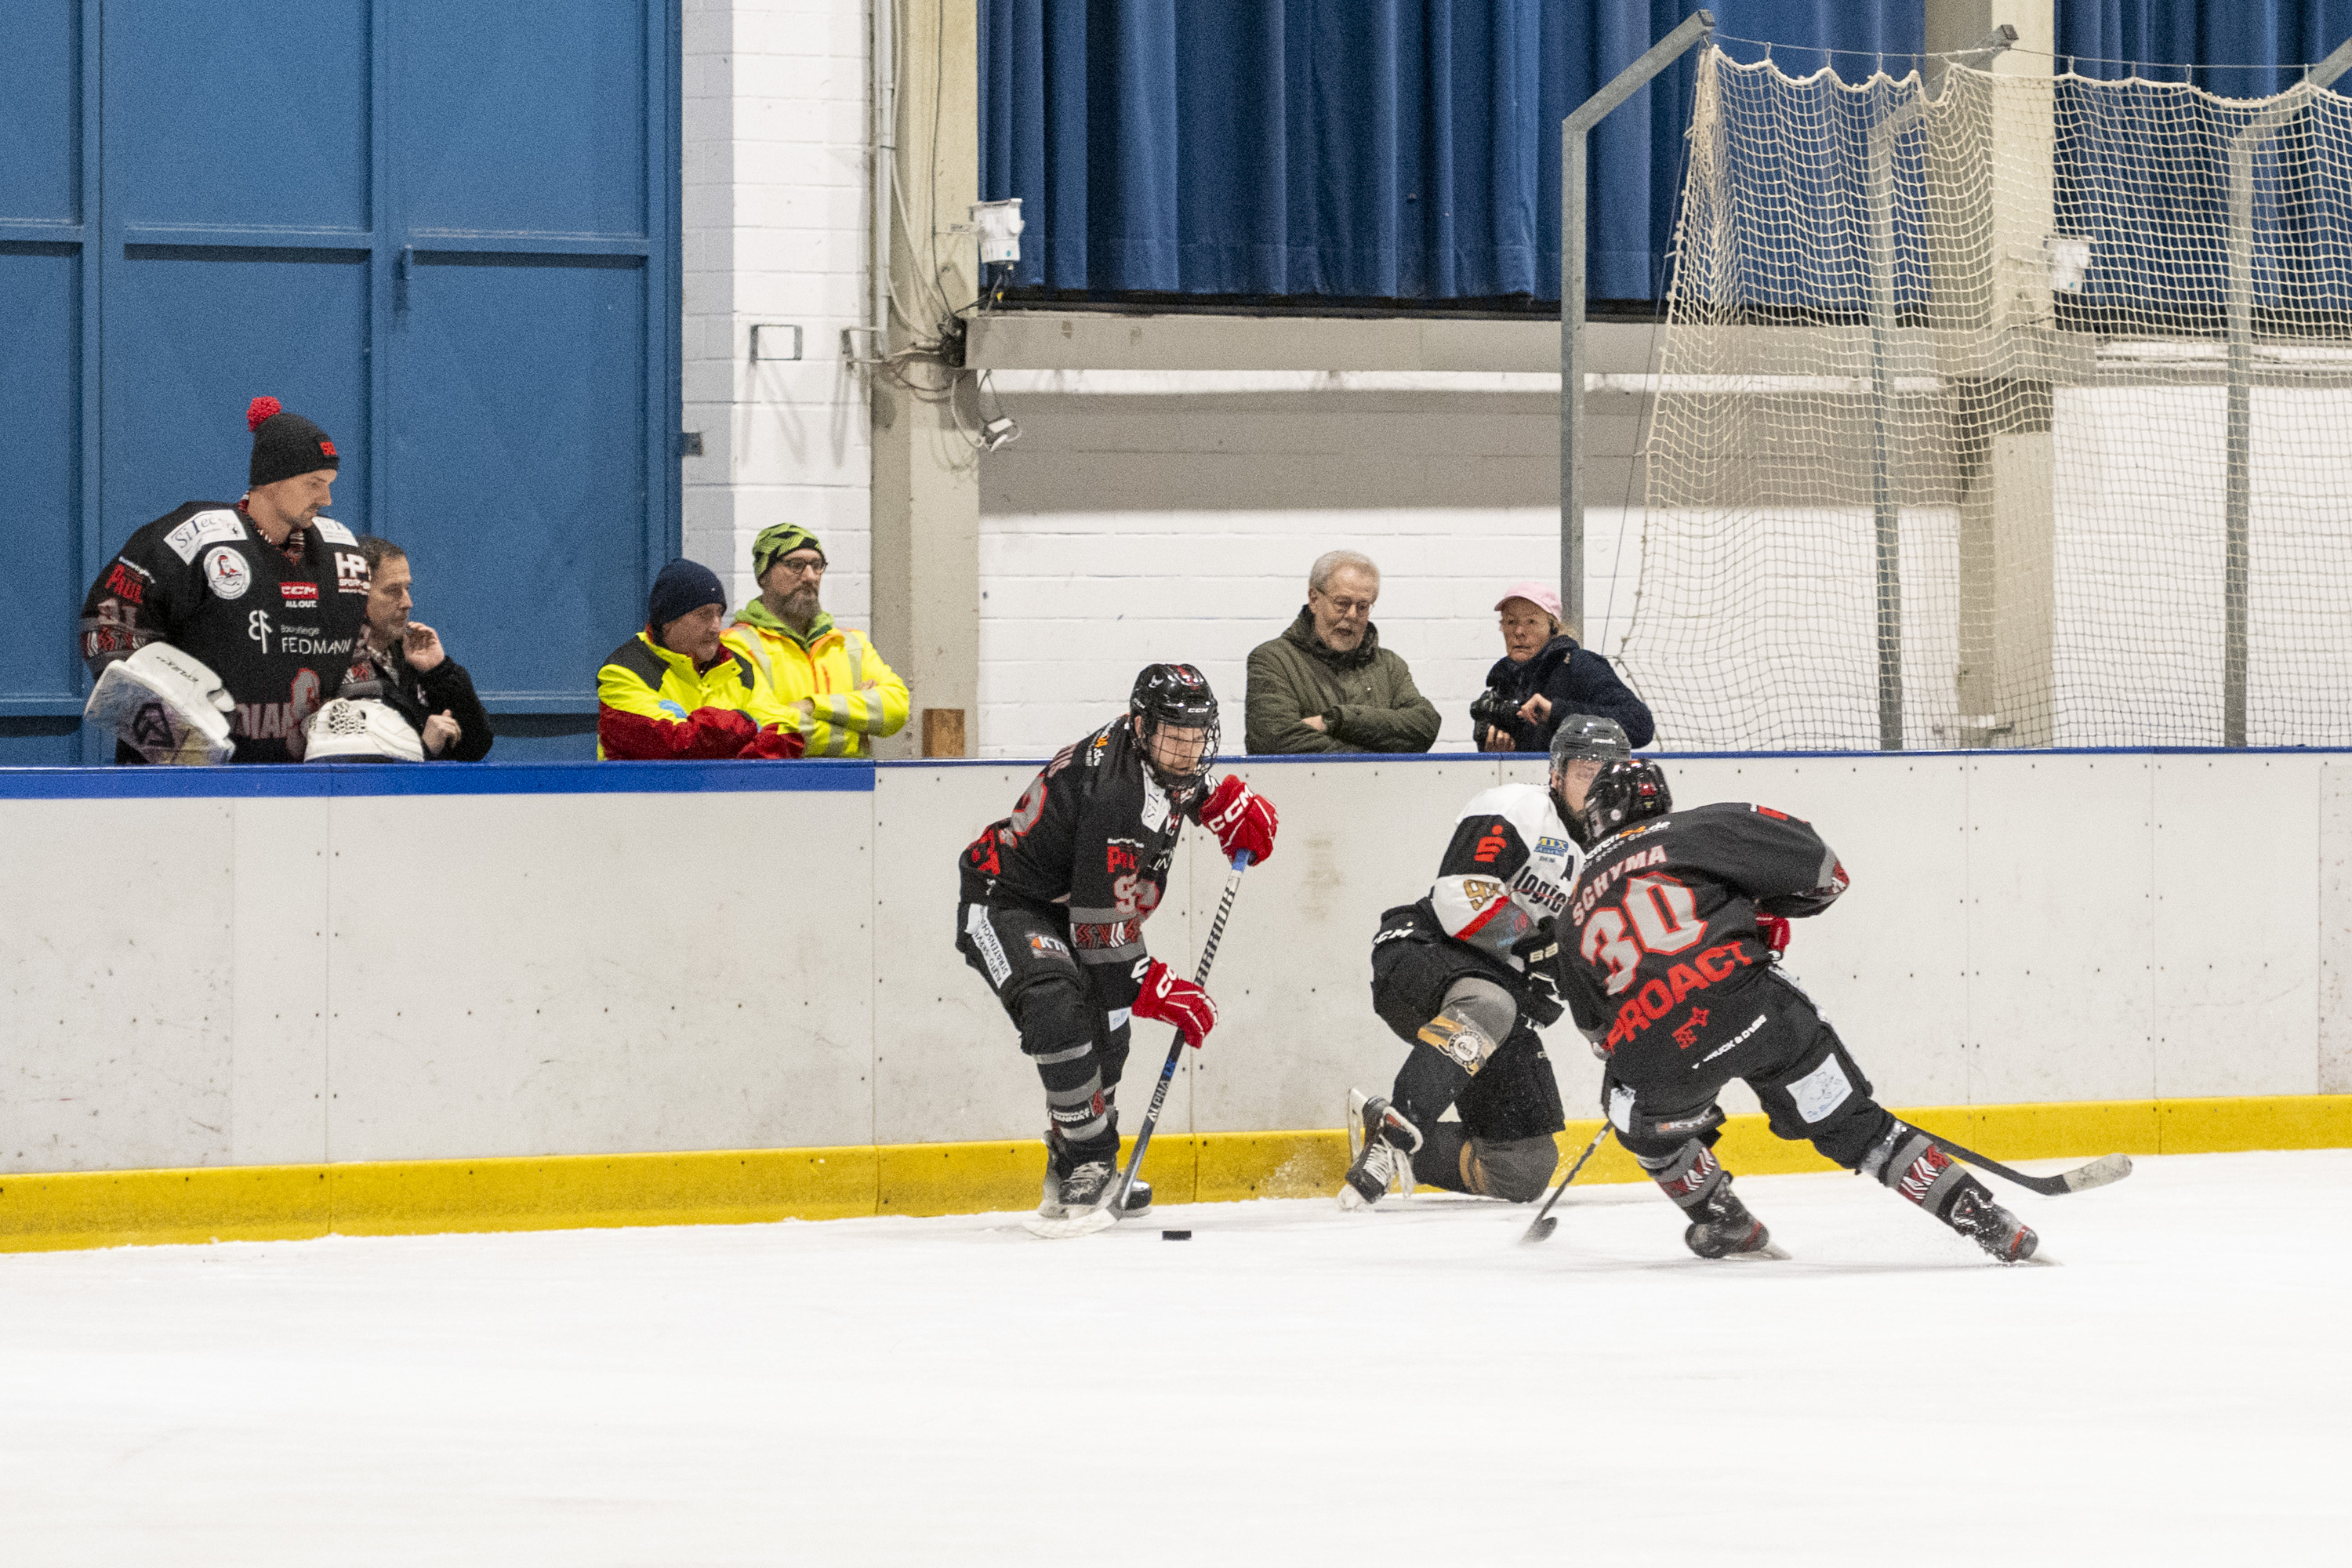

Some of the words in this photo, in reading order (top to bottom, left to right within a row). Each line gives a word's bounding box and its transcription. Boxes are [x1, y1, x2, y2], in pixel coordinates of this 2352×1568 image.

[281, 586, 316, 595] CCM
[282, 637, 351, 655] FEDMANN
[1208, 784, 1254, 832] CCM
[1571, 844, 1668, 927] SCHYMA
[1193, 887, 1236, 987] ARRIOR
[1581, 870, 1708, 996] 30
[1602, 941, 1752, 1055] PROACT
[1147, 1080, 1170, 1124] ALPHA
